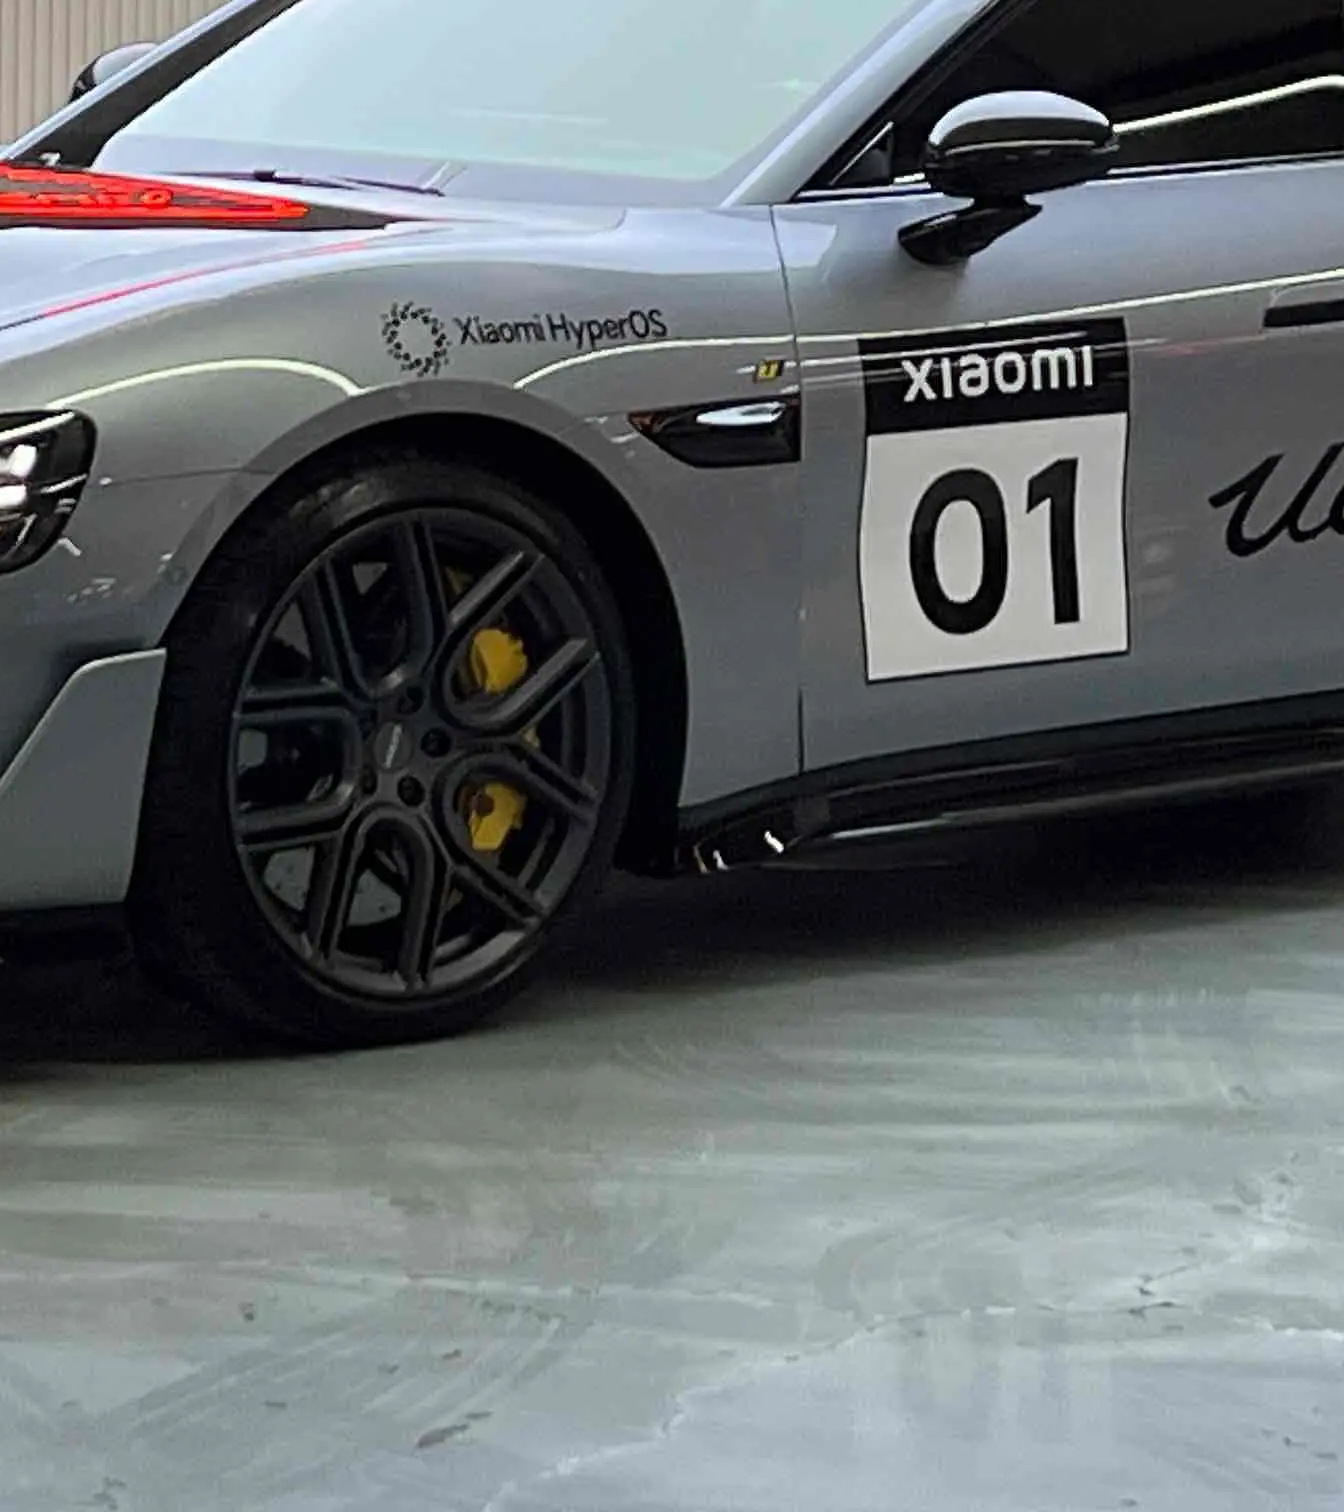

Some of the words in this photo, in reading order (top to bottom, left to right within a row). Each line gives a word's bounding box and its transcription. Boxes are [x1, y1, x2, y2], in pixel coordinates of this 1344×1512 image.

[453, 313, 545, 345] Xiaomi
[545, 309, 668, 350] HyperOS
[900, 345, 1094, 403] xiaomi
[909, 457, 1081, 635] 01
